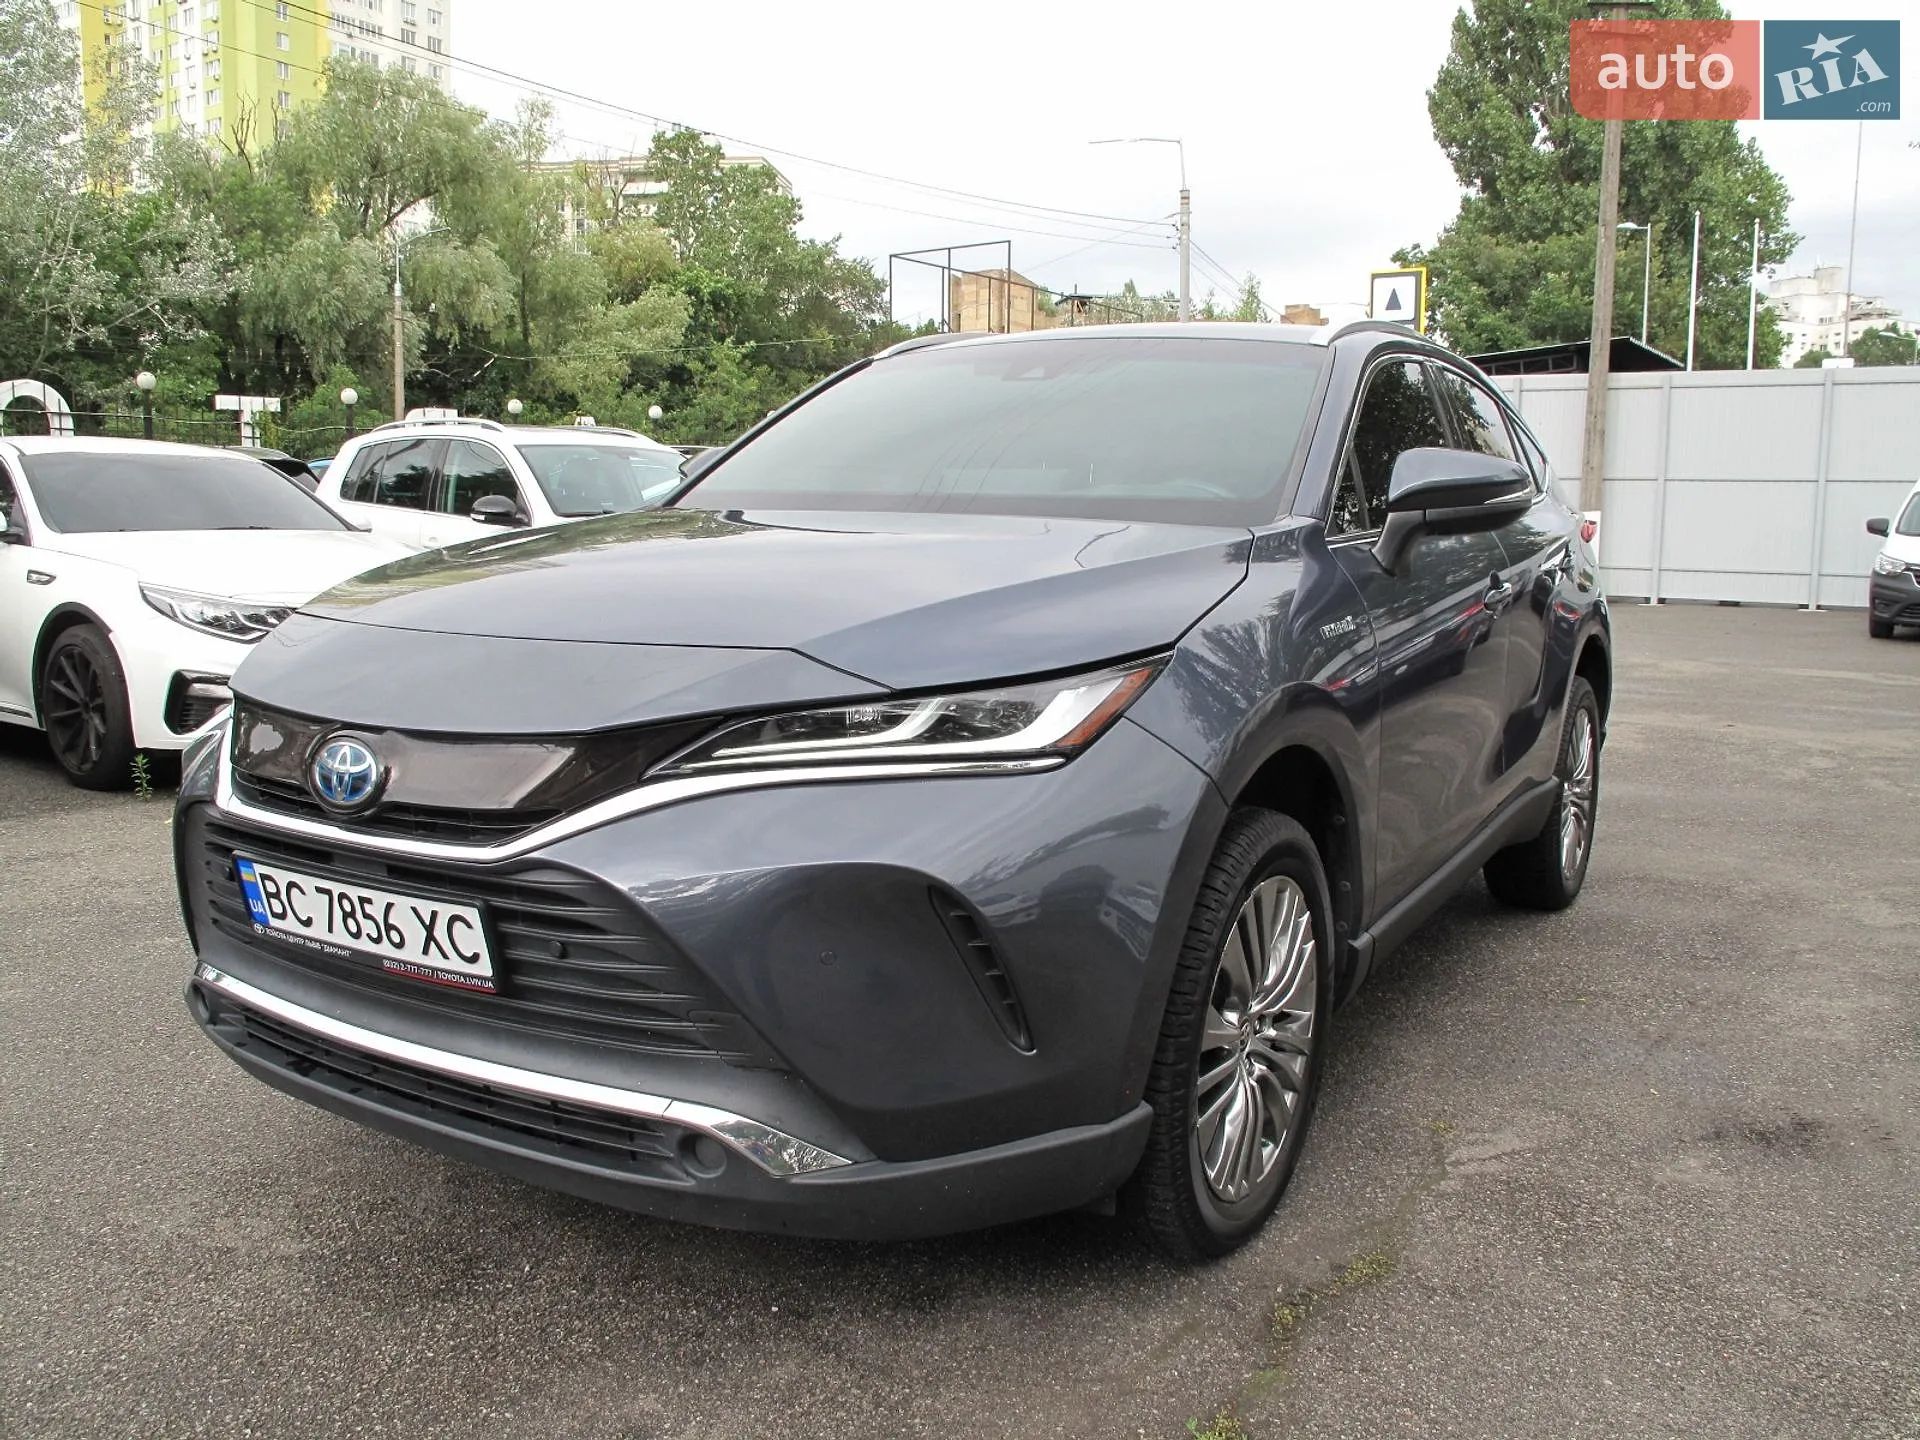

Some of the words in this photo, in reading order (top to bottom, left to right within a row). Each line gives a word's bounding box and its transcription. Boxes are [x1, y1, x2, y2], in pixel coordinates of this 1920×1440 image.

[249, 898, 266, 915] UA
[259, 872, 313, 928] BC
[314, 885, 406, 950] 7856
[410, 906, 481, 965] XC
